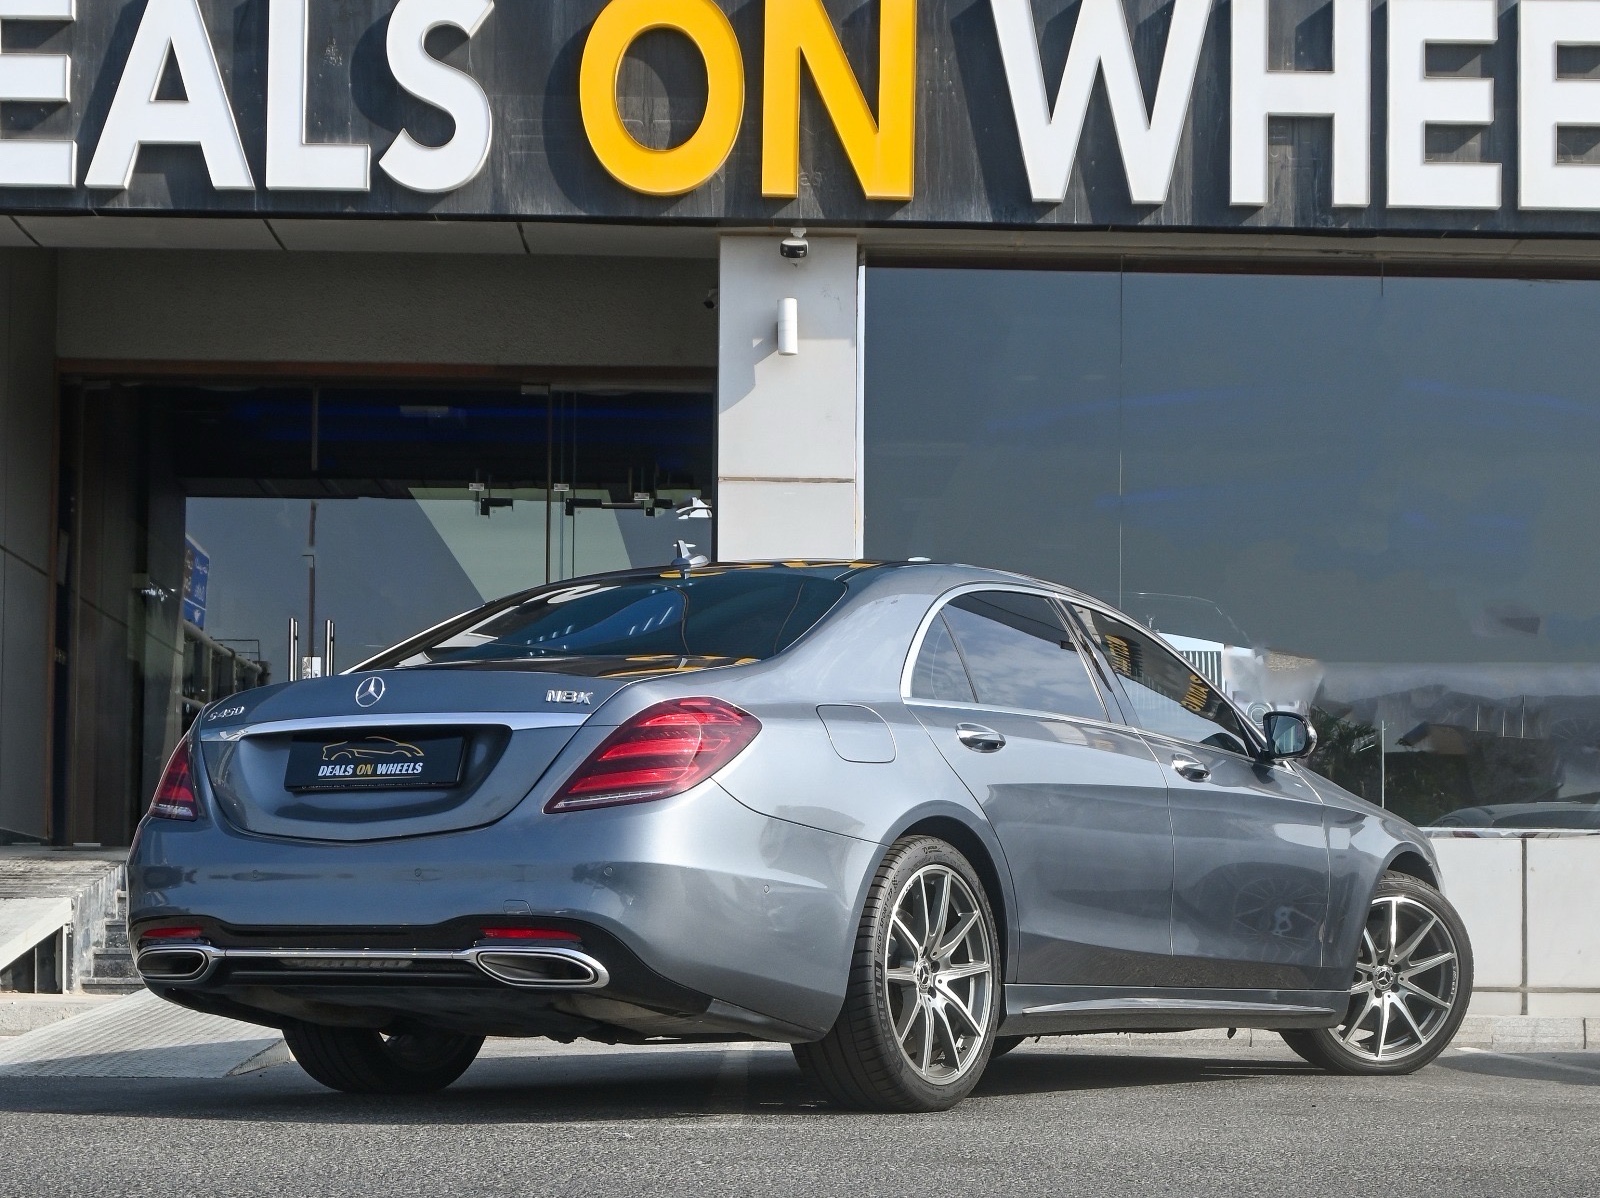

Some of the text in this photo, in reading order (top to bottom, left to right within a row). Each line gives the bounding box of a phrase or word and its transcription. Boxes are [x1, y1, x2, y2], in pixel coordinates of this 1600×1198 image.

[0, 0, 1600, 210] EALS ON WHEE
[207, 705, 245, 722] S450
[317, 761, 424, 777] DEALS ON WHEELS
[879, 902, 890, 929] SPORT
[876, 931, 884, 955] PILOT
[875, 966, 896, 1053] MICHELIN
